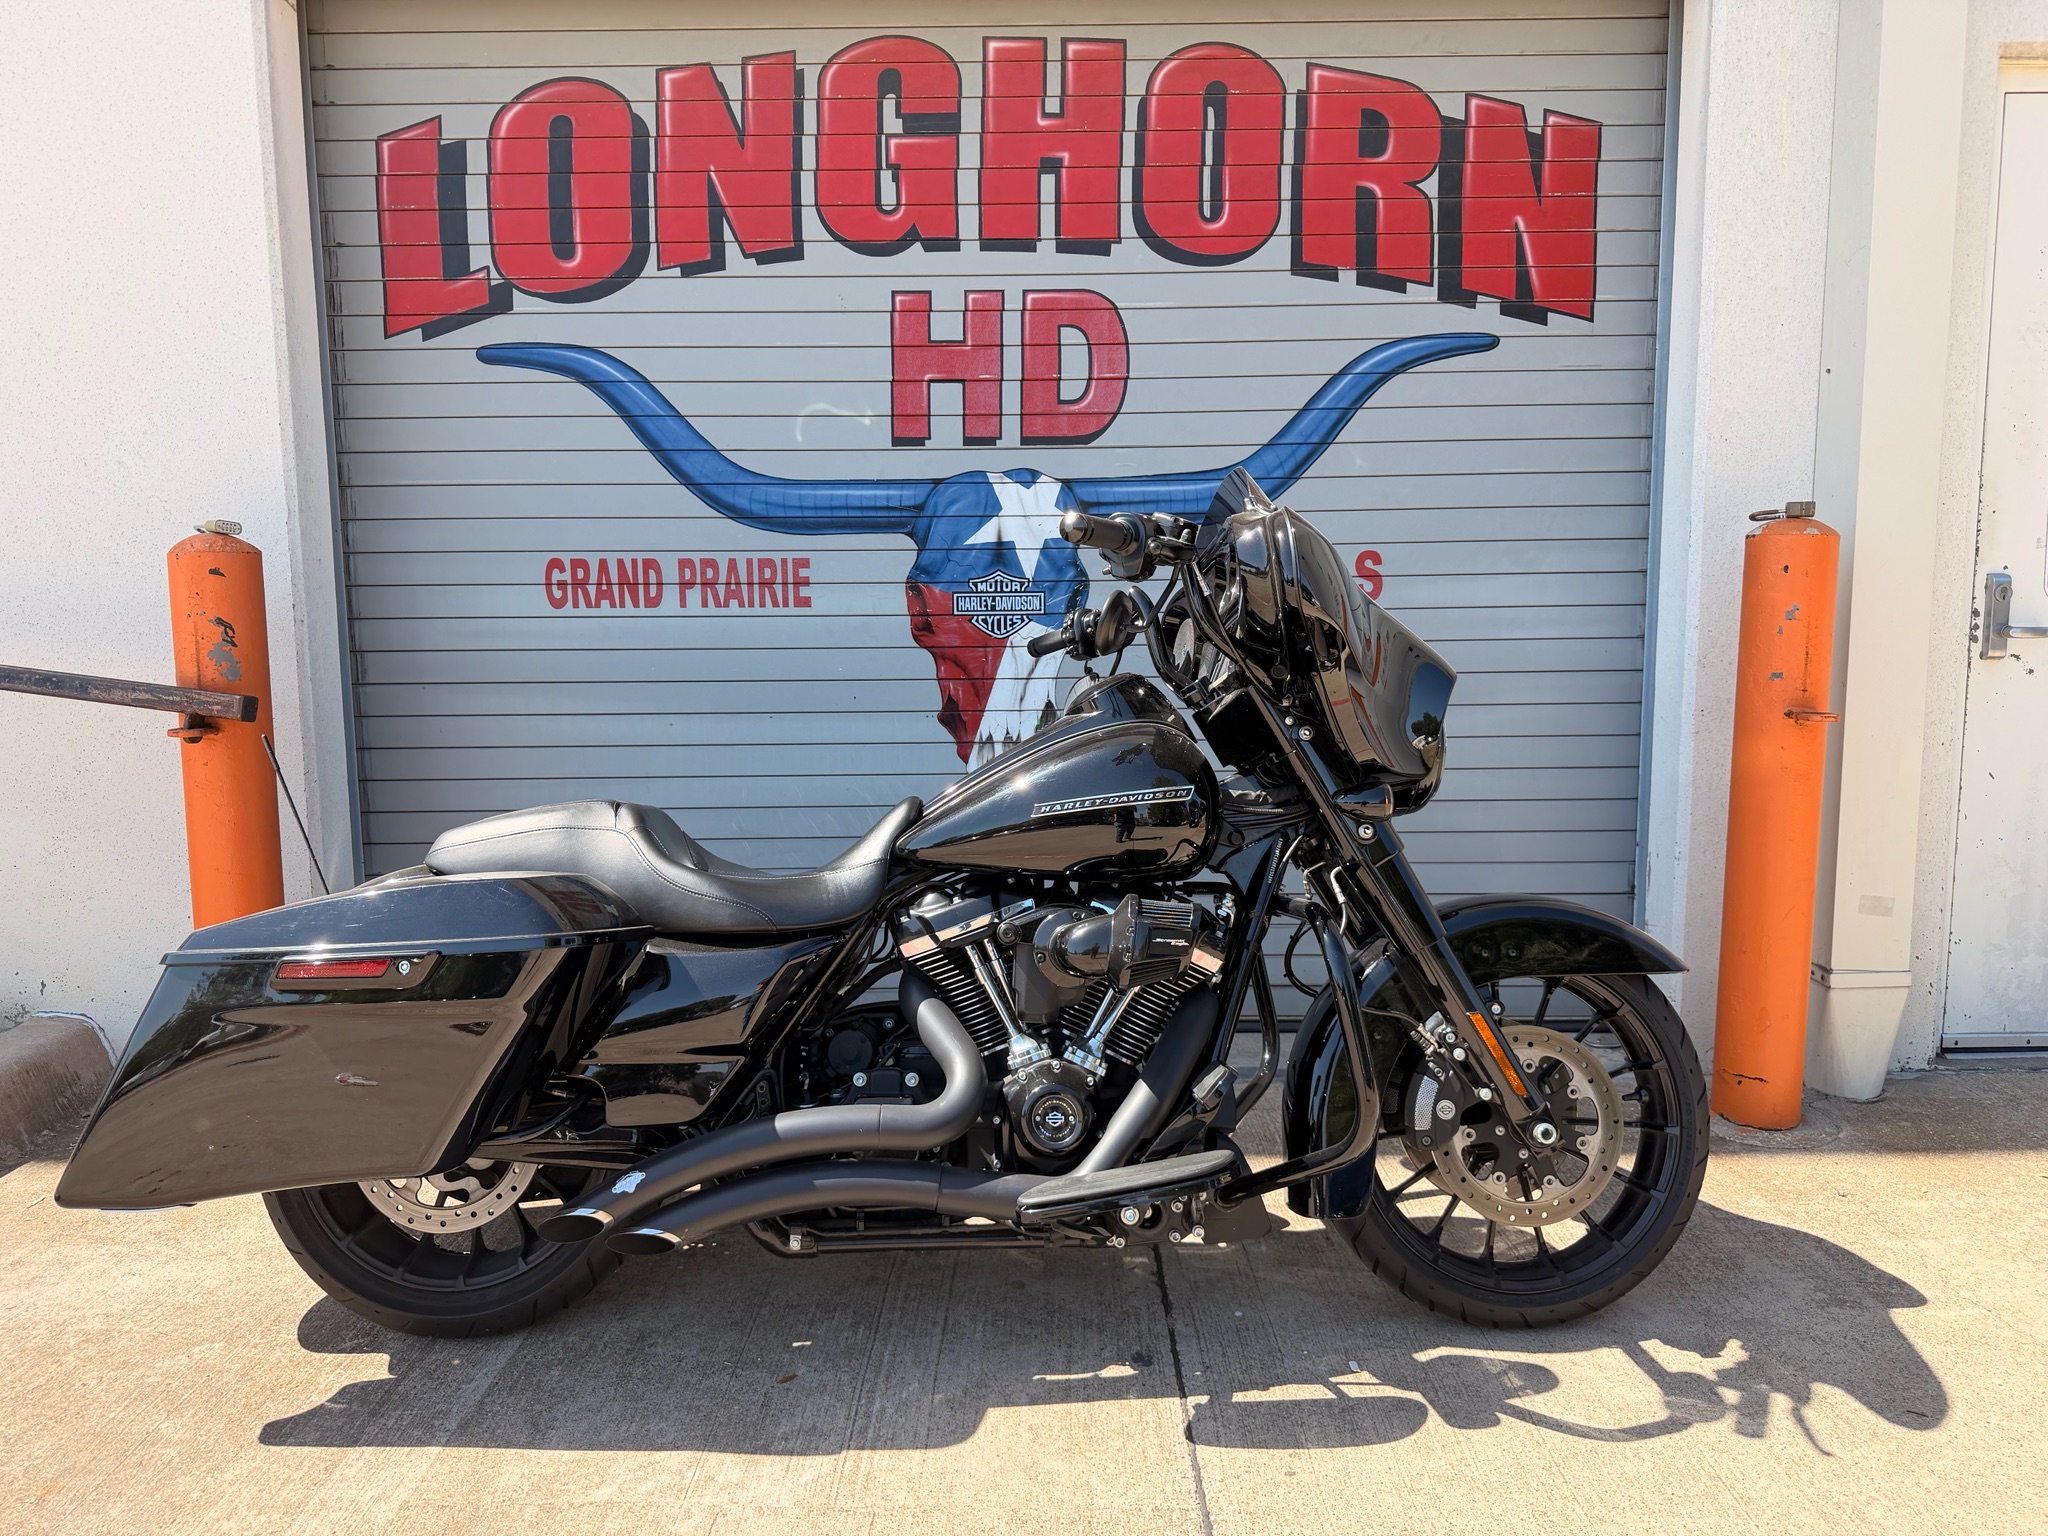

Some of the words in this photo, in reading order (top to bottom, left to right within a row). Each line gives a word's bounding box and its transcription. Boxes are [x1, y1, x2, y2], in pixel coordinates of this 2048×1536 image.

[376, 35, 1602, 342] LONGHORN
[891, 288, 1129, 446] HD
[545, 557, 663, 610] GRAND
[677, 557, 812, 609] PRAIRIE
[977, 576, 1021, 592] MOTOR
[958, 595, 1041, 611] HARLEY-DAVIDSON
[977, 615, 1022, 635] CYCLES
[1040, 789, 1188, 813] HARLEY-DAVIDSON
